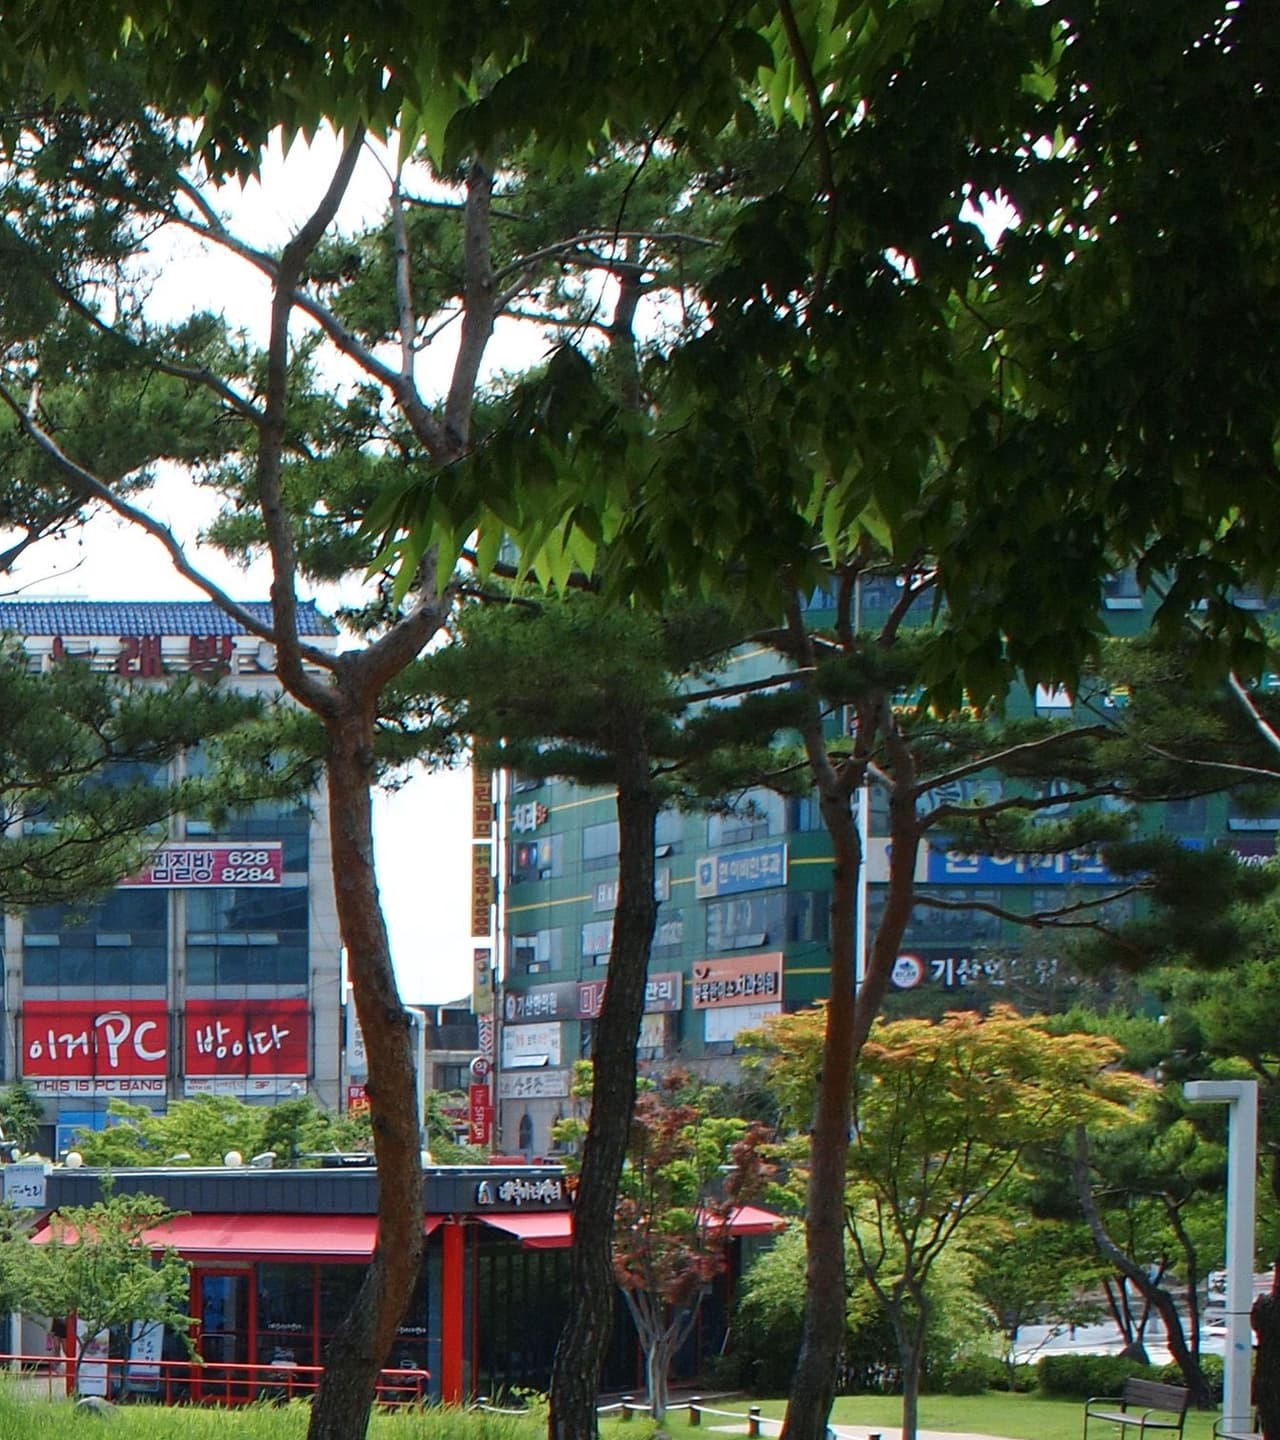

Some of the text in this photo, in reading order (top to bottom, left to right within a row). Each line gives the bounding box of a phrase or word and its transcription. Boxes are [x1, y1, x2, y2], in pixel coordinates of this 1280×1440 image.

[151, 851, 215, 883] 찜질방
[228, 851, 269, 866] 628
[221, 867, 276, 882] 8284
[95, 1011, 167, 1068] PC
[196, 1020, 290, 1059] 방이다
[34, 1080, 163, 1092] THIS IS PC BANG
